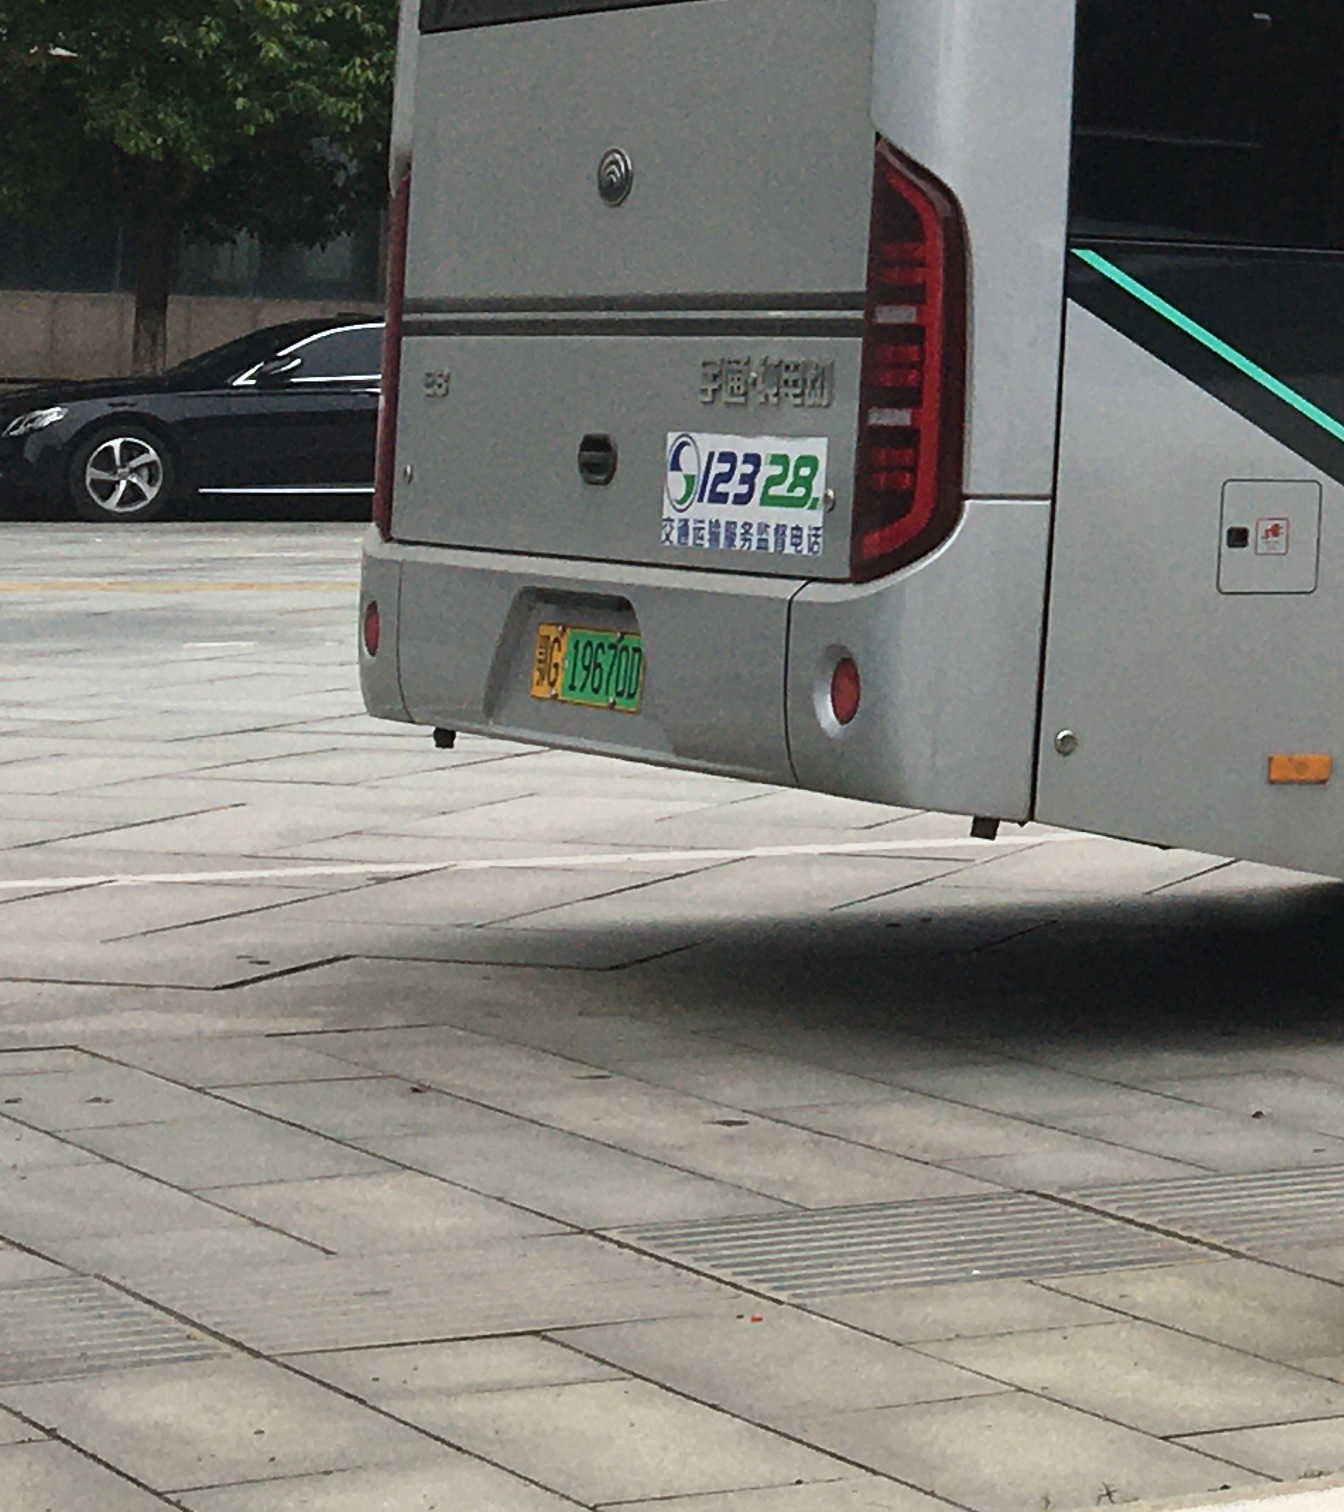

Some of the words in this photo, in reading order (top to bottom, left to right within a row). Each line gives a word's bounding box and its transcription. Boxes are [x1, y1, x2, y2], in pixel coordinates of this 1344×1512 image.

[661, 516, 823, 555] 交通运输服务监督电话
